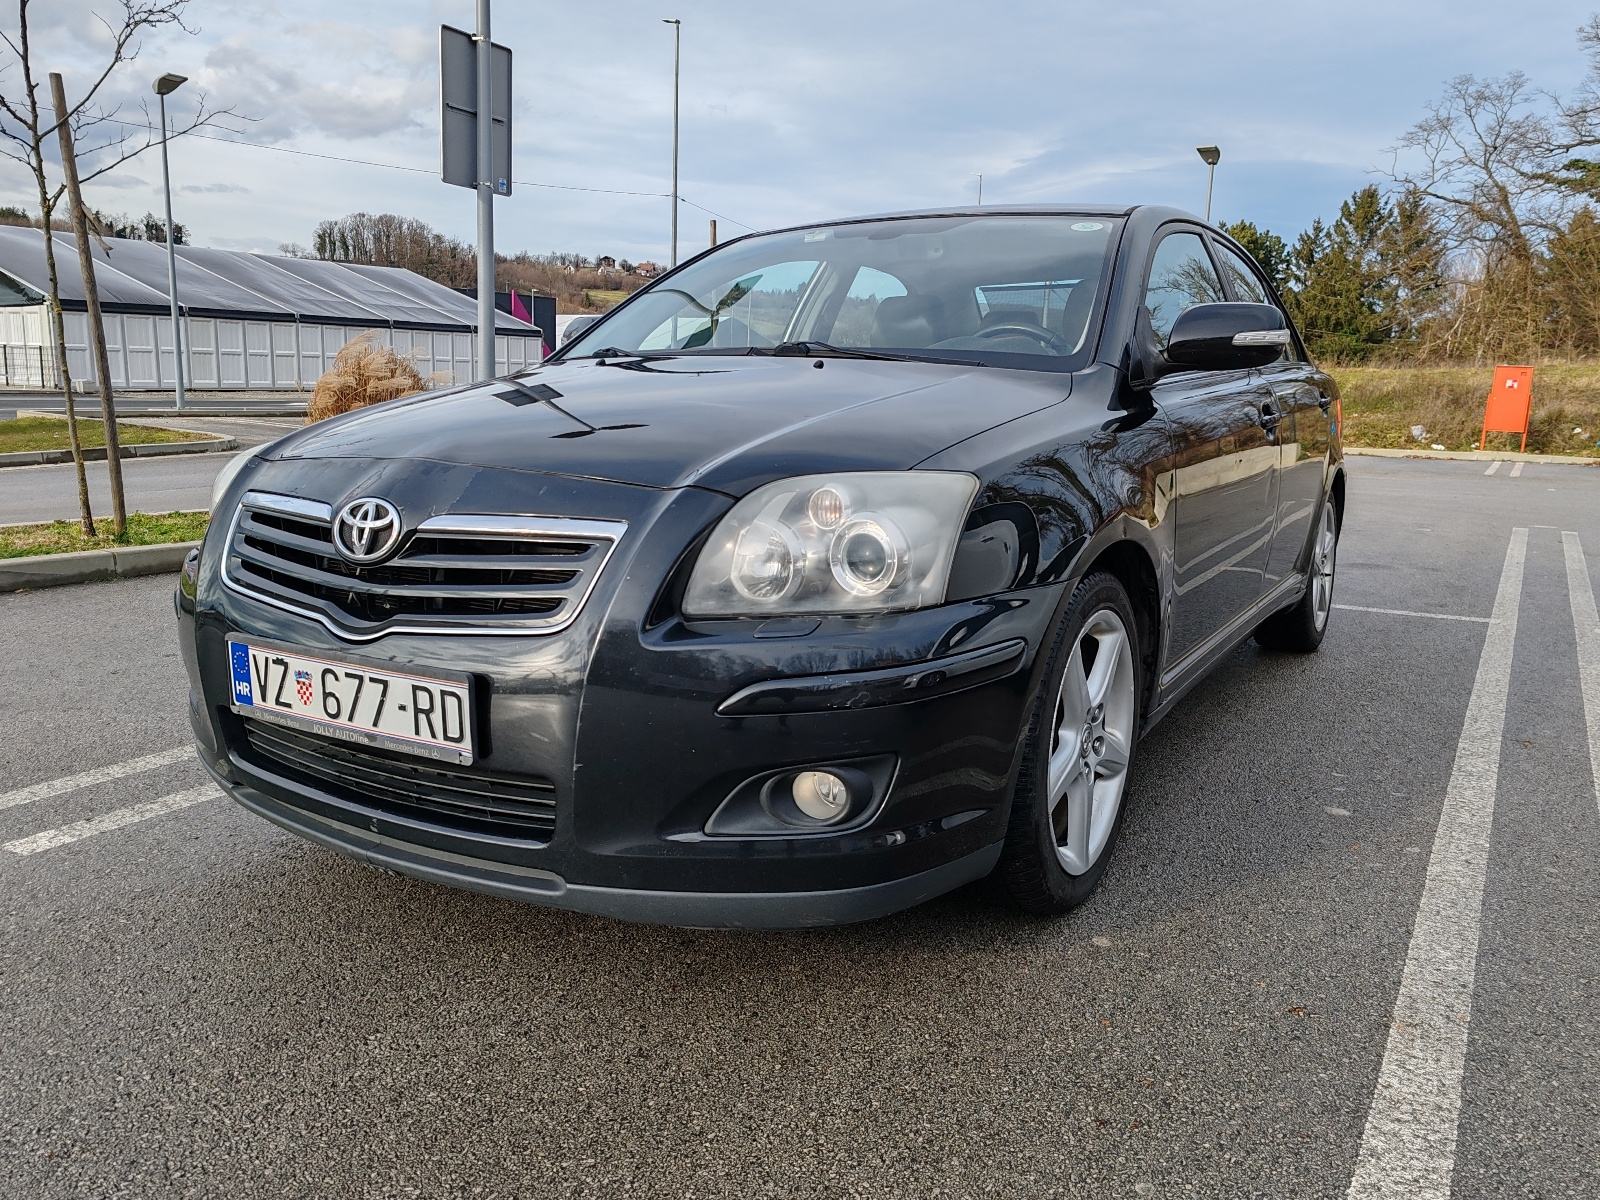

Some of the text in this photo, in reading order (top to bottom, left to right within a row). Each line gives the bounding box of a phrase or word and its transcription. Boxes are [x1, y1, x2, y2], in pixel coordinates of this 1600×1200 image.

[235, 681, 251, 697] HR
[252, 653, 292, 709] VŽ
[313, 724, 333, 737] JOLLY
